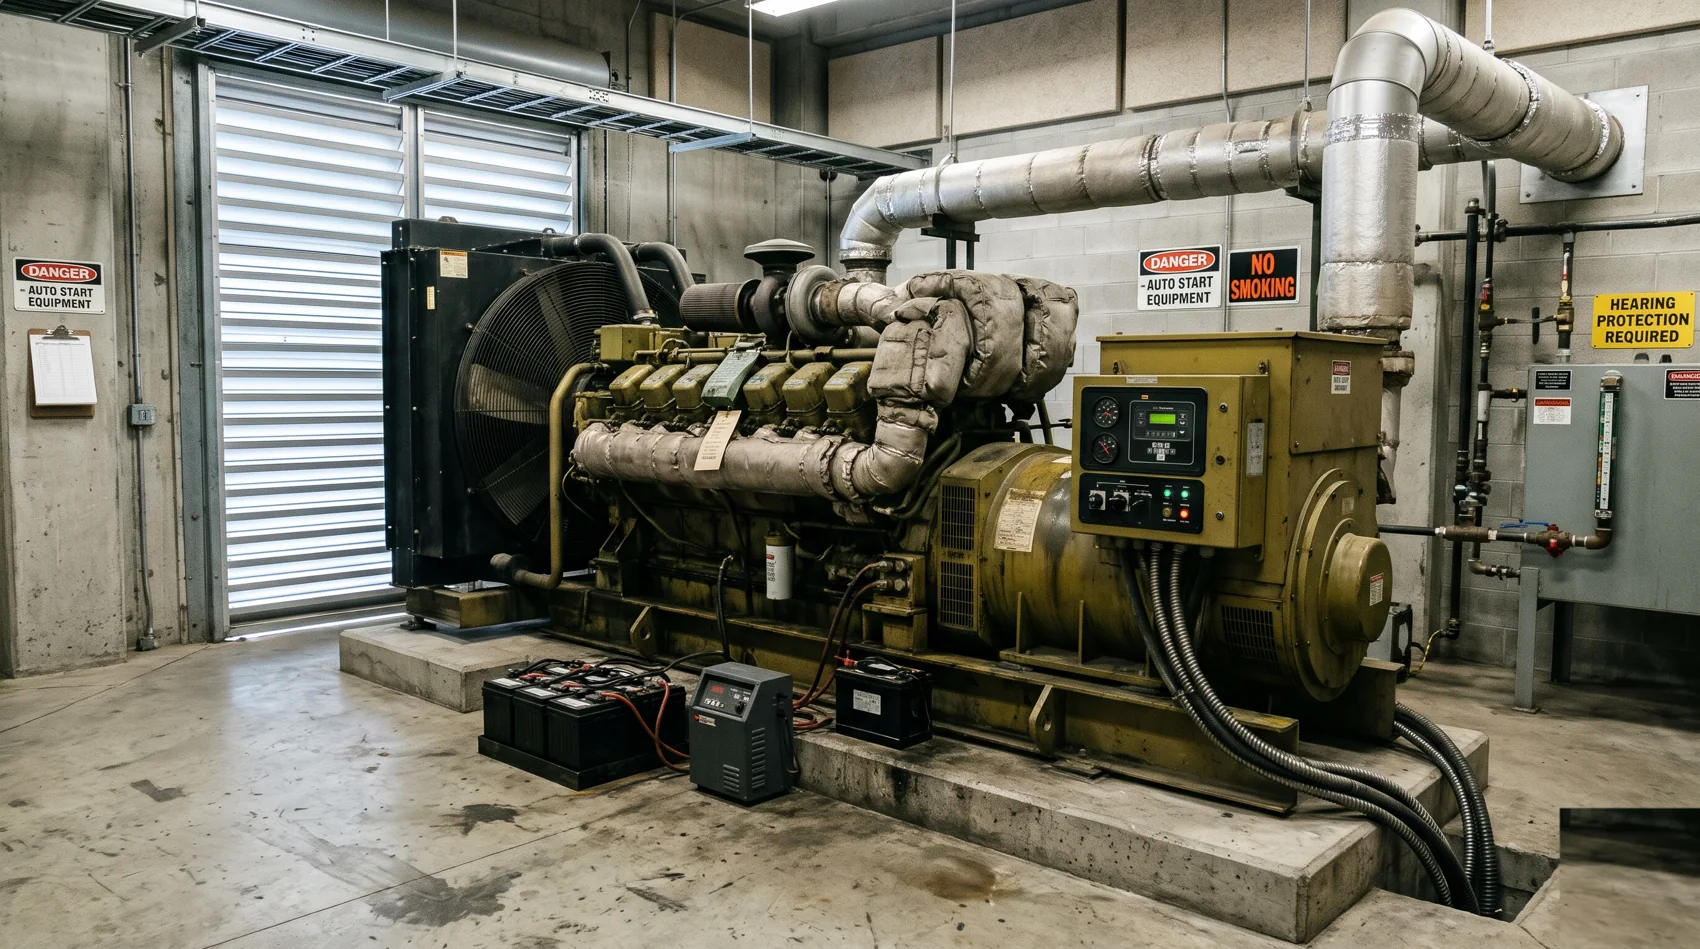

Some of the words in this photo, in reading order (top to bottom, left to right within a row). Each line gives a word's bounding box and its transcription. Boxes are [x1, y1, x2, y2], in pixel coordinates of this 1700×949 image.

[1151, 253, 1207, 269] DANGER
[1251, 253, 1275, 275] NO
[29, 266, 90, 280] DANGER
[1178, 275, 1214, 289] START
[1231, 277, 1295, 299] SMOKING
[28, 285, 57, 296] AUTO
[60, 286, 93, 298] START
[29, 297, 91, 309] EQUIPMENT
[1147, 291, 1211, 307] EQUIPMENT
[1610, 297, 1676, 310] HEARING
[1597, 313, 1690, 327] PROTECTION
[1605, 330, 1679, 344] REQUIRED
